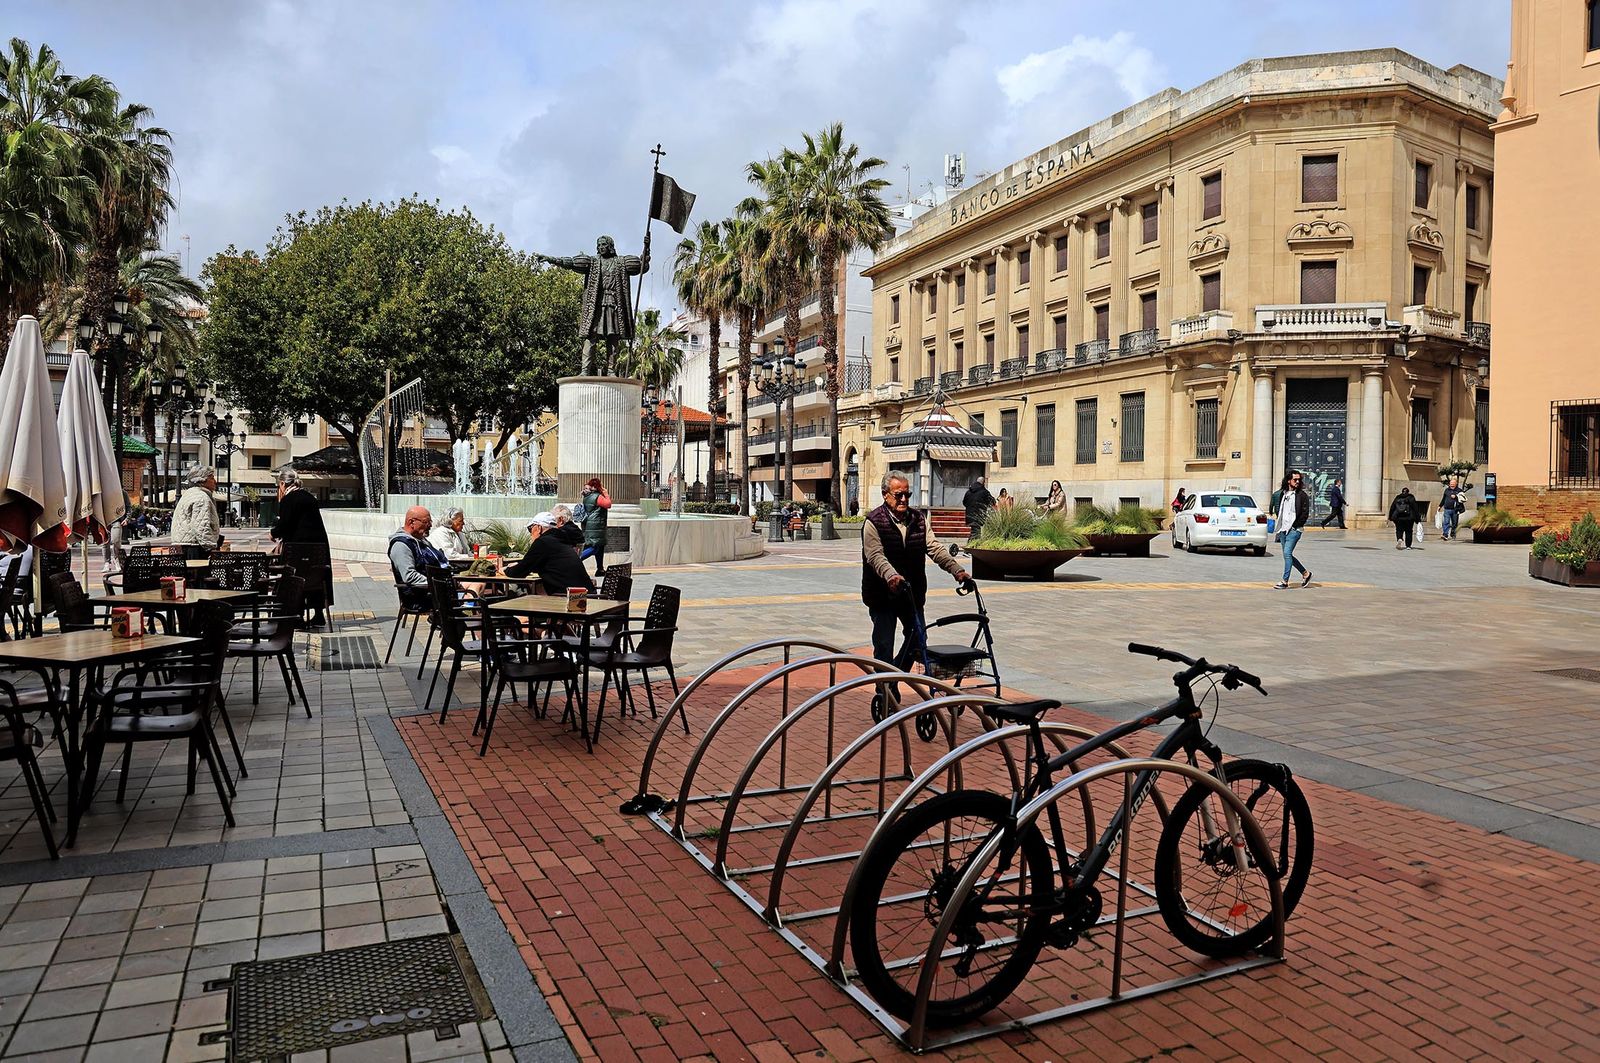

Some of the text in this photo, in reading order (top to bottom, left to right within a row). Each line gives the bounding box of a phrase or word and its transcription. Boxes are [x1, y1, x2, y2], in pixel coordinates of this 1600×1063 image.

[951, 141, 1095, 225] BANCO DE ESPAÑA
